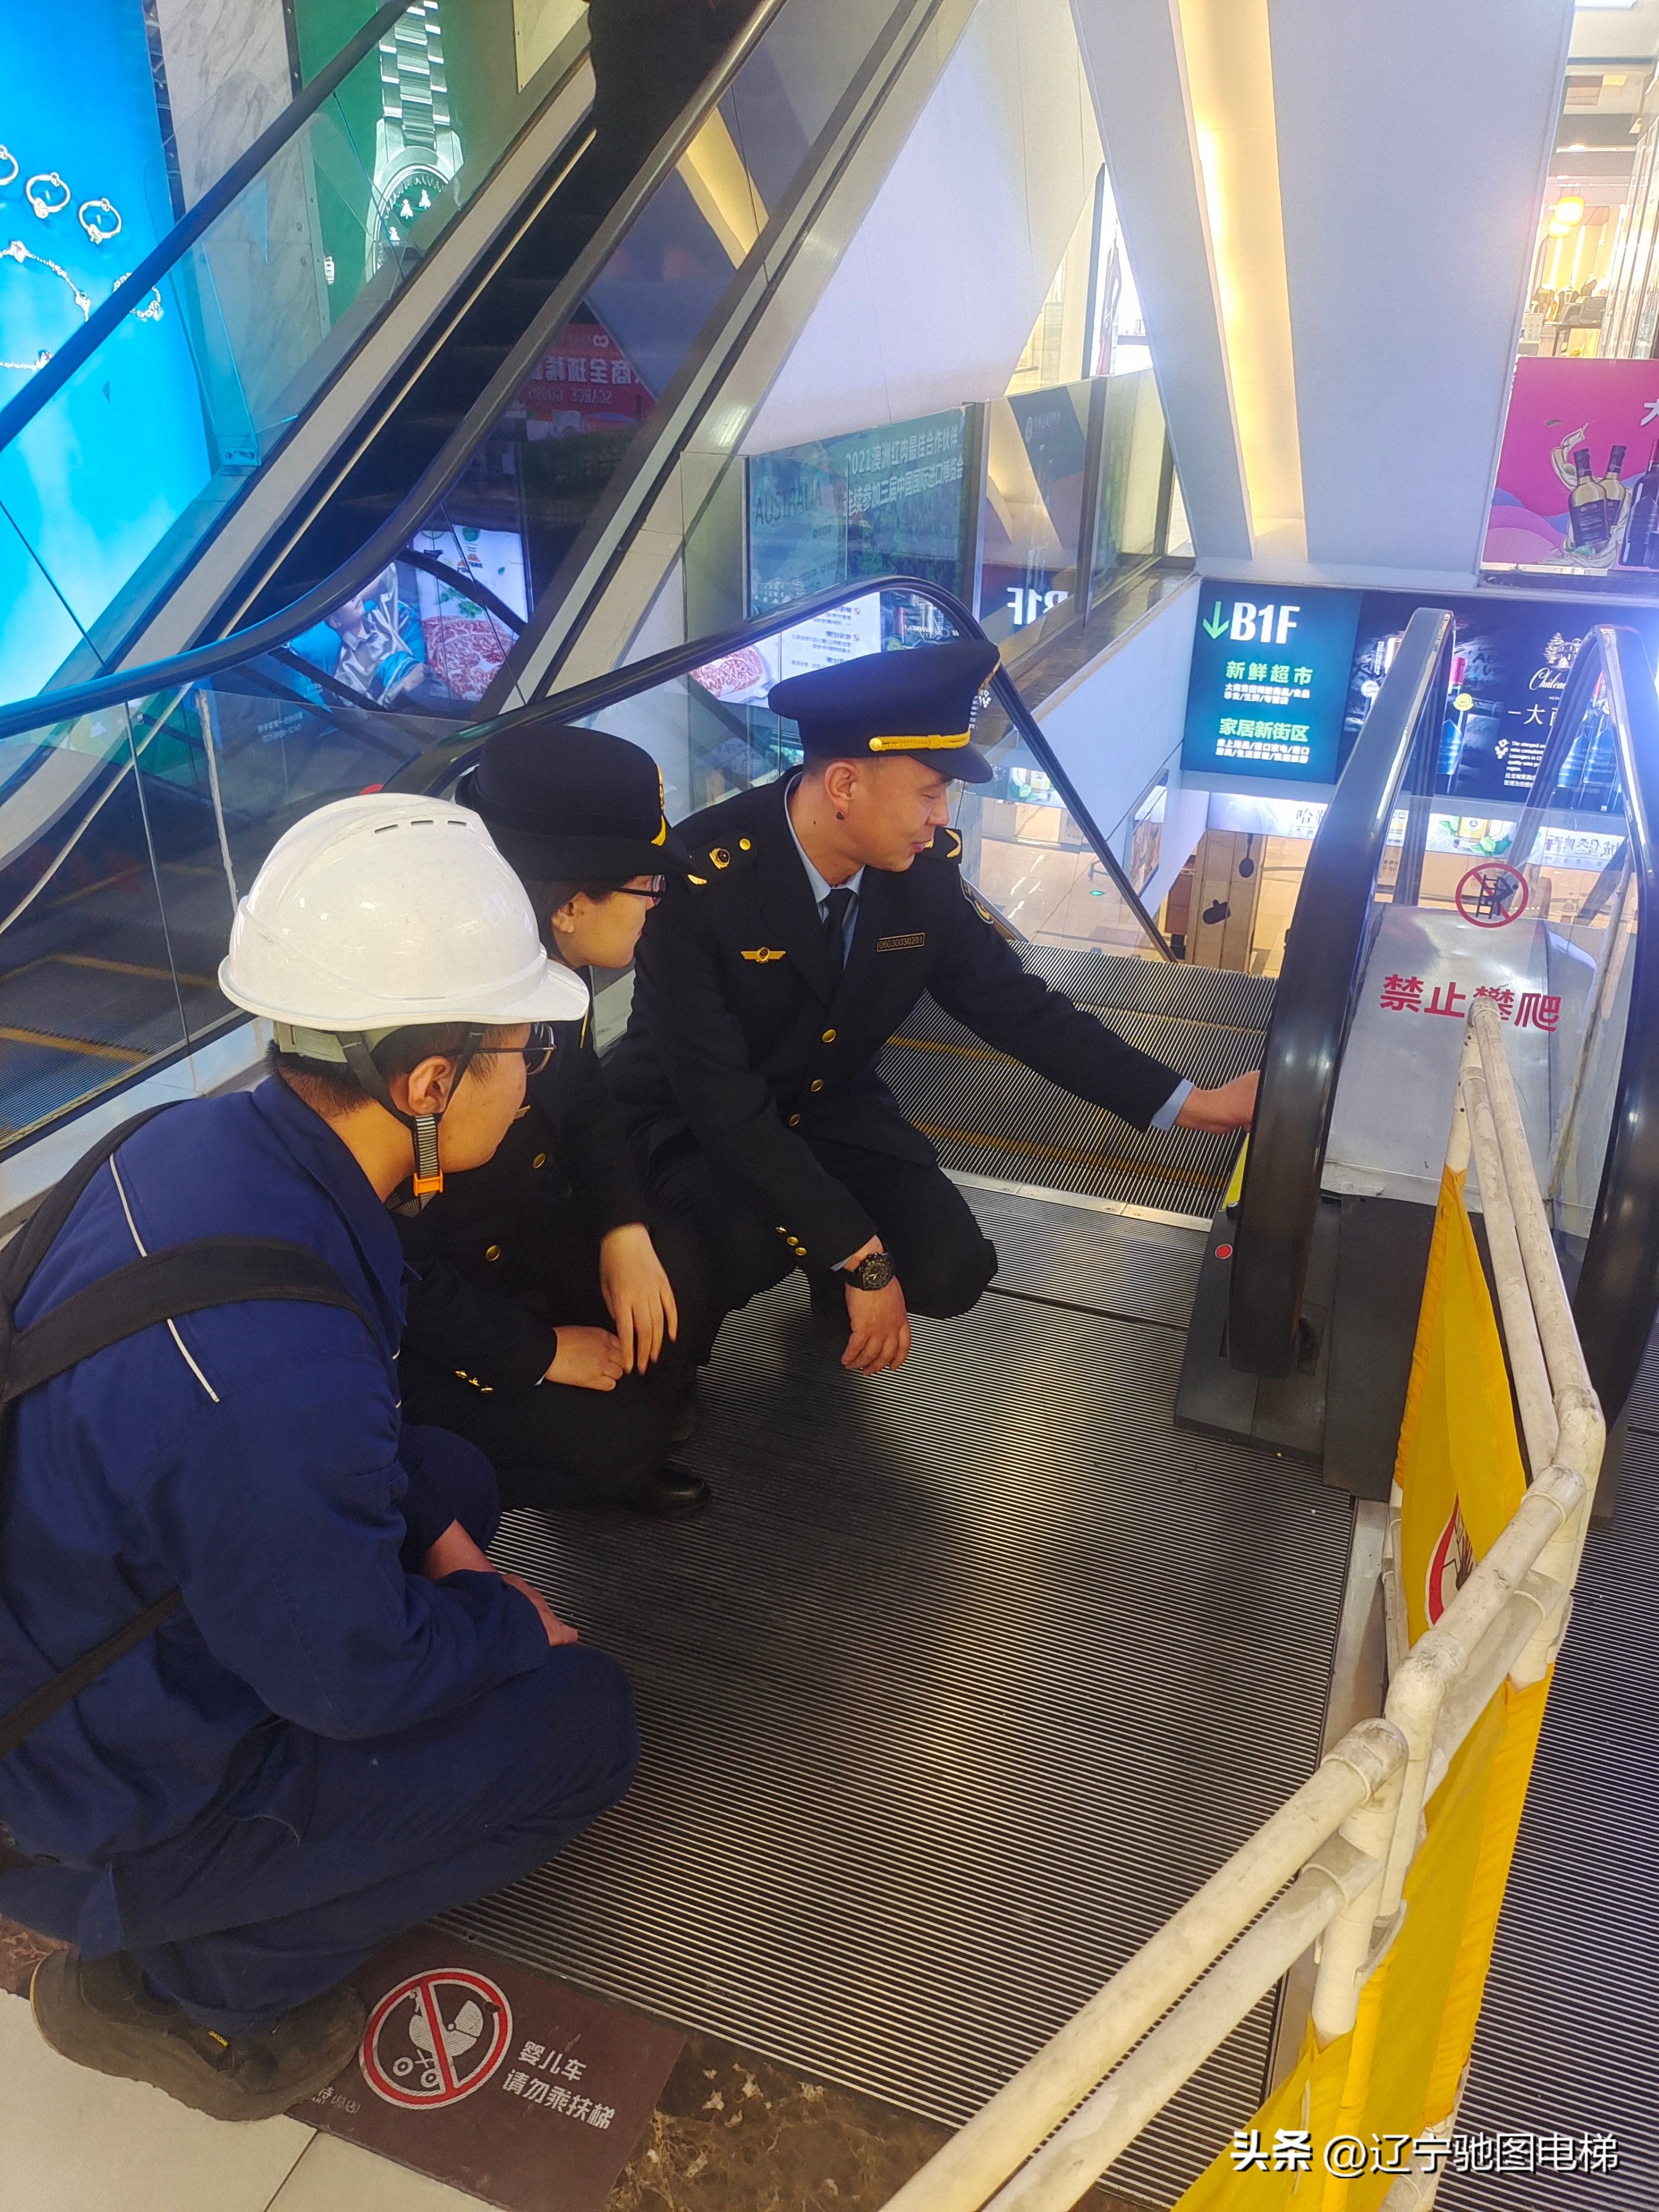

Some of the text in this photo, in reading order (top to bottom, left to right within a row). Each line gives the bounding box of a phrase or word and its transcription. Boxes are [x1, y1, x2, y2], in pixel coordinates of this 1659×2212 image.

[1230, 602, 1300, 644] B1F
[1225, 660, 1313, 685] 新鲜超市
[1219, 718, 1309, 742] 家居新街区
[518, 2041, 587, 2081] 婴儿车
[502, 2069, 615, 2129] 请勿乘扶梯
